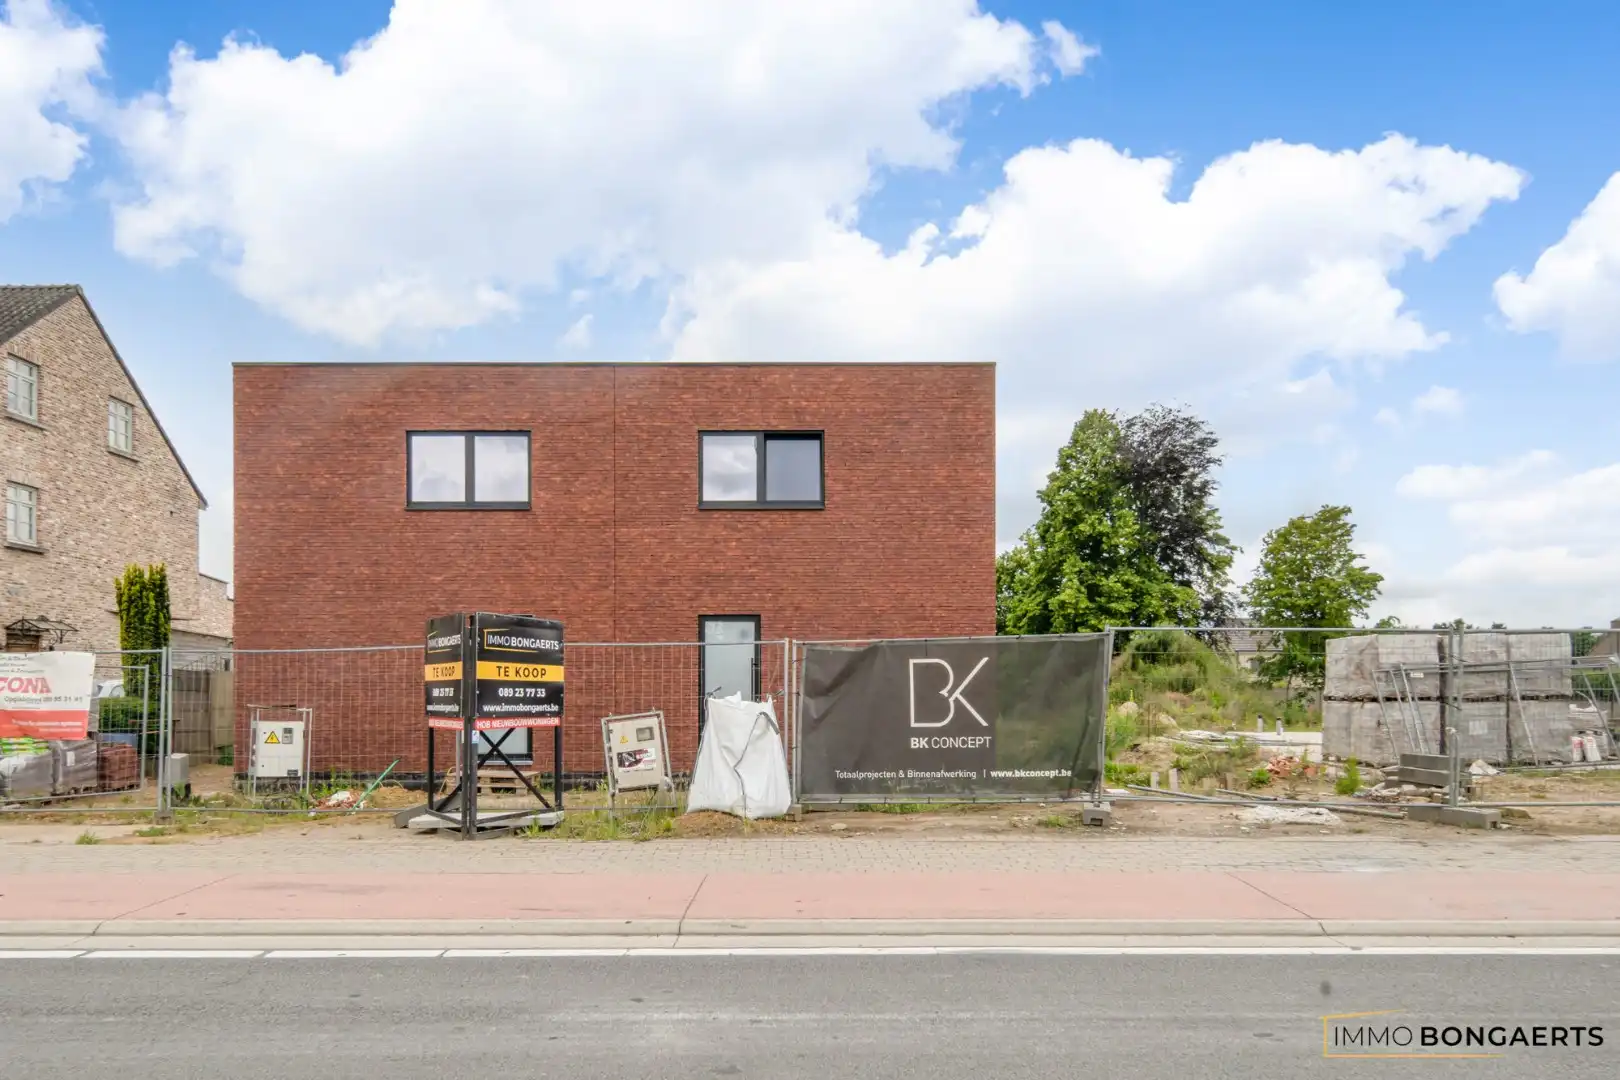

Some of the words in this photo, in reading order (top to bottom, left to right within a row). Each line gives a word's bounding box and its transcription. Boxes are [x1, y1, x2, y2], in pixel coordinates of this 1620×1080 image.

[487, 634, 511, 645] IMMO
[511, 636, 559, 650] BONGAERTS
[432, 667, 439, 678] TE
[440, 665, 455, 677] KOOP
[496, 665, 510, 678] TE
[515, 667, 547, 679] KOOP
[498, 688, 514, 697] 089
[514, 688, 525, 697] 23
[526, 688, 536, 697] 77
[536, 688, 546, 697] 33
[482, 703, 559, 713] www.immobongaerts.be
[910, 737, 929, 749] BK
[931, 736, 992, 749] CONCEPT
[835, 769, 897, 780] Totaalprojecten
[898, 770, 905, 778] &
[907, 769, 977, 780] Binnenafwerking
[990, 768, 1072, 779] www.bkconcept.be
